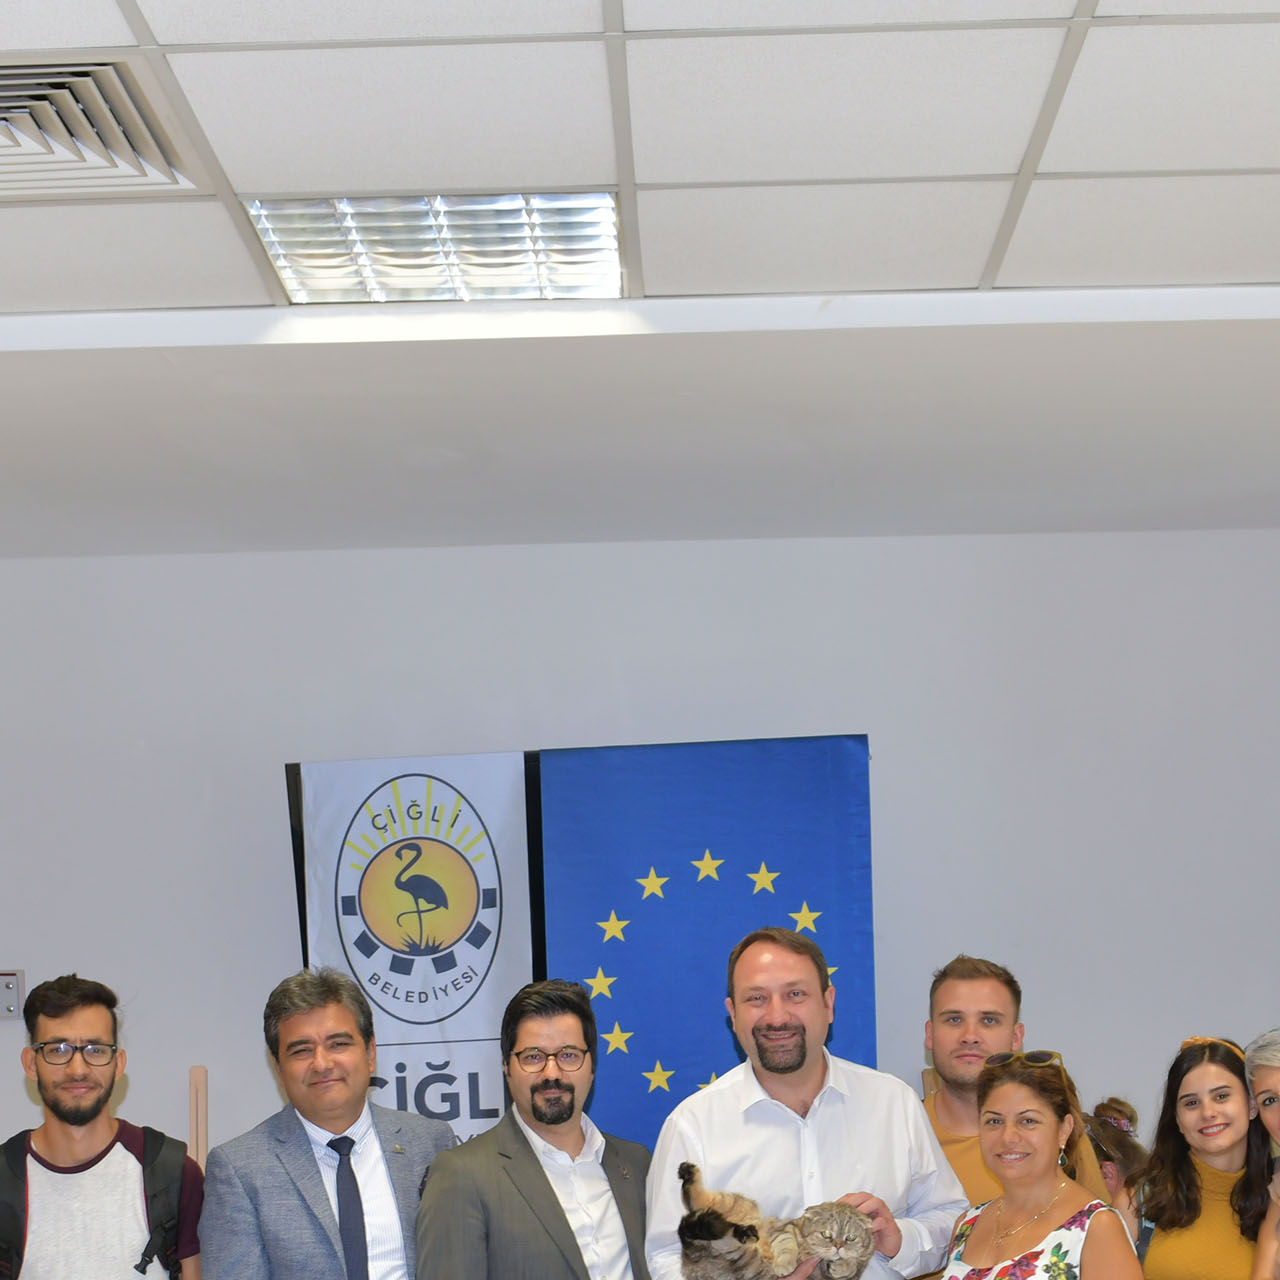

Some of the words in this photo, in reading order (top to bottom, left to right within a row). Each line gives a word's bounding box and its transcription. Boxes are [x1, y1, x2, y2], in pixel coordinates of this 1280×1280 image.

[371, 799, 462, 833] ÇİĞLİ
[368, 965, 479, 1004] BELEDİYESİ
[369, 1060, 511, 1121] İĞL
